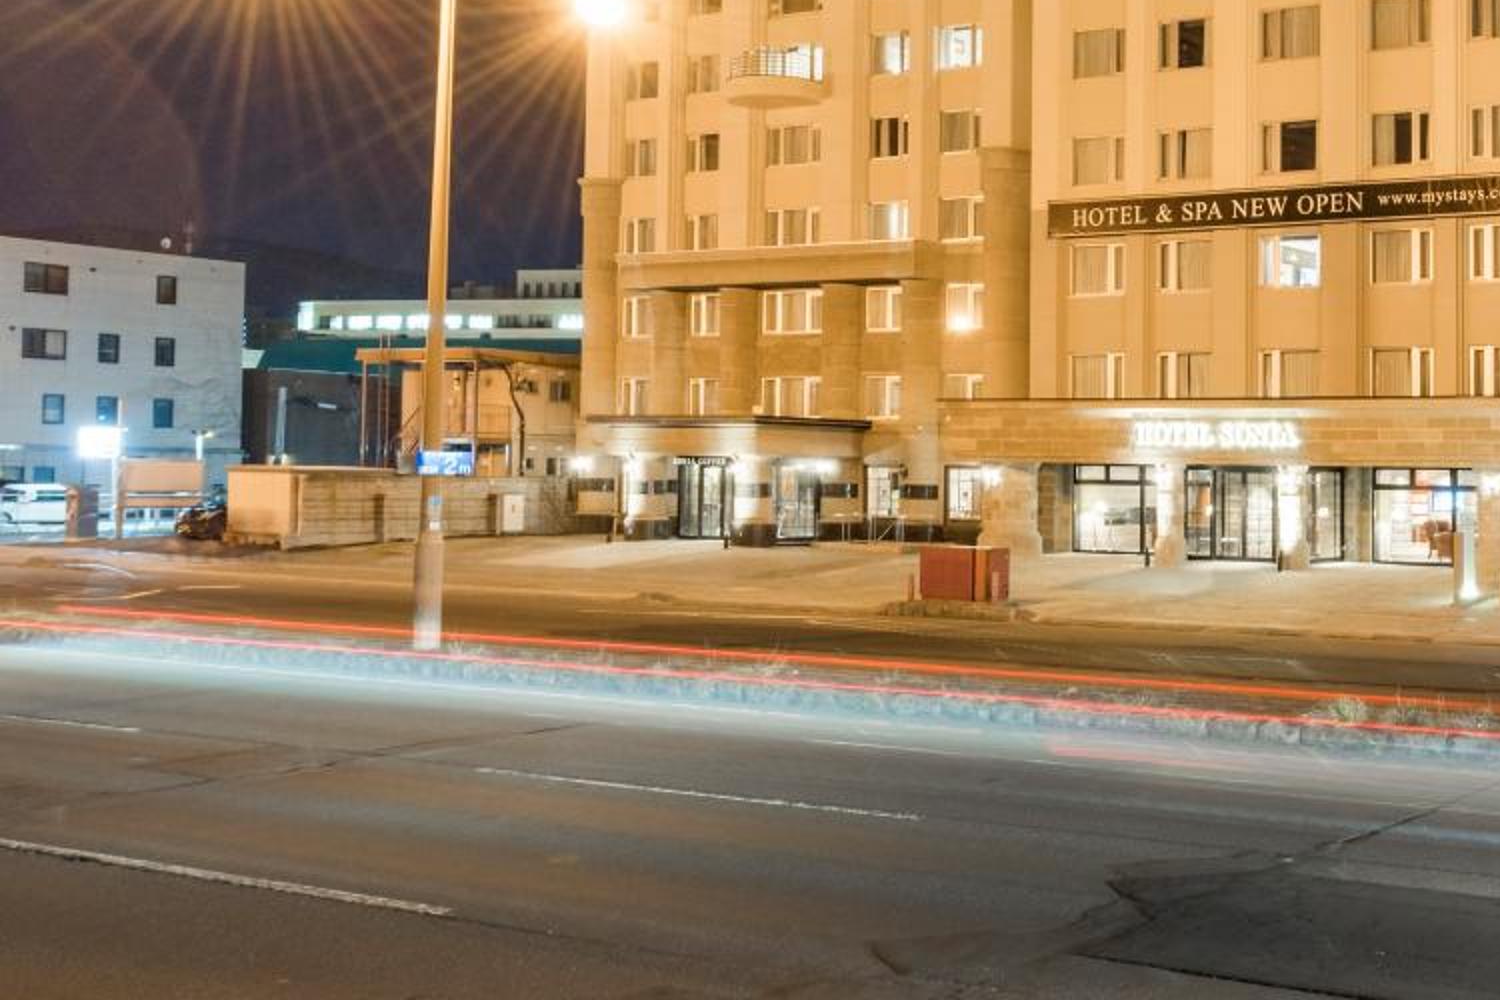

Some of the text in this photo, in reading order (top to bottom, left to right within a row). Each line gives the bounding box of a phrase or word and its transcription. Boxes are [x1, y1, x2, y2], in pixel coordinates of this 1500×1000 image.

[1072, 205, 1148, 227] HOTEL
[1155, 203, 1173, 223] &
[1181, 200, 1223, 222] SPA
[1231, 196, 1288, 219] NEW
[1296, 191, 1364, 215] OPEN
[1135, 422, 1301, 447] HOTEL SONIA
